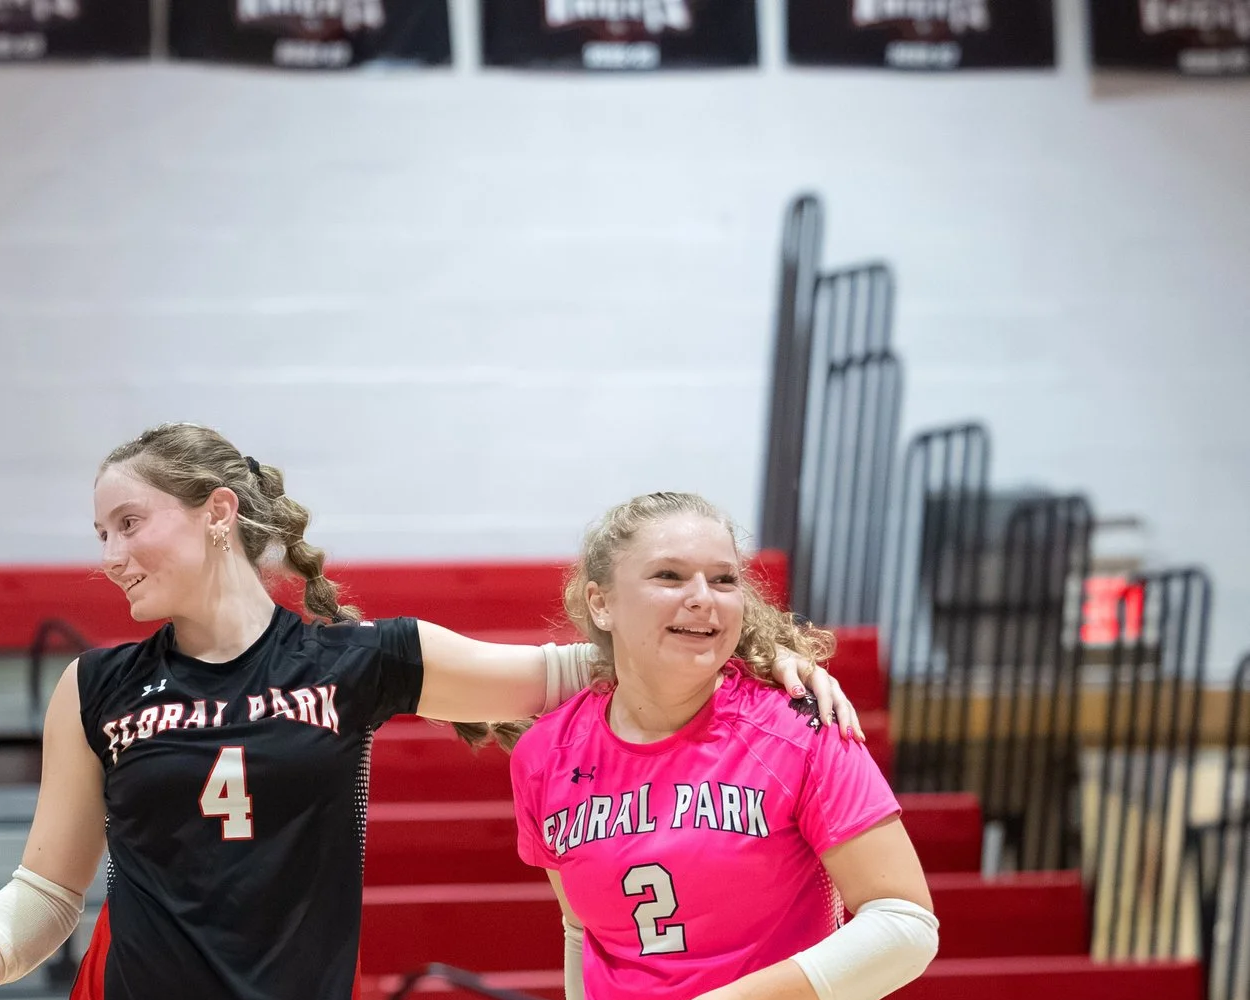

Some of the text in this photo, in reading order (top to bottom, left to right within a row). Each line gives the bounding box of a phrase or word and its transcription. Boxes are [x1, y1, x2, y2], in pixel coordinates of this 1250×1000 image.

[246, 684, 340, 735] PARK
[200, 745, 254, 841] 4
[543, 780, 770, 858] FLORAL PARK
[621, 862, 688, 957] 2
